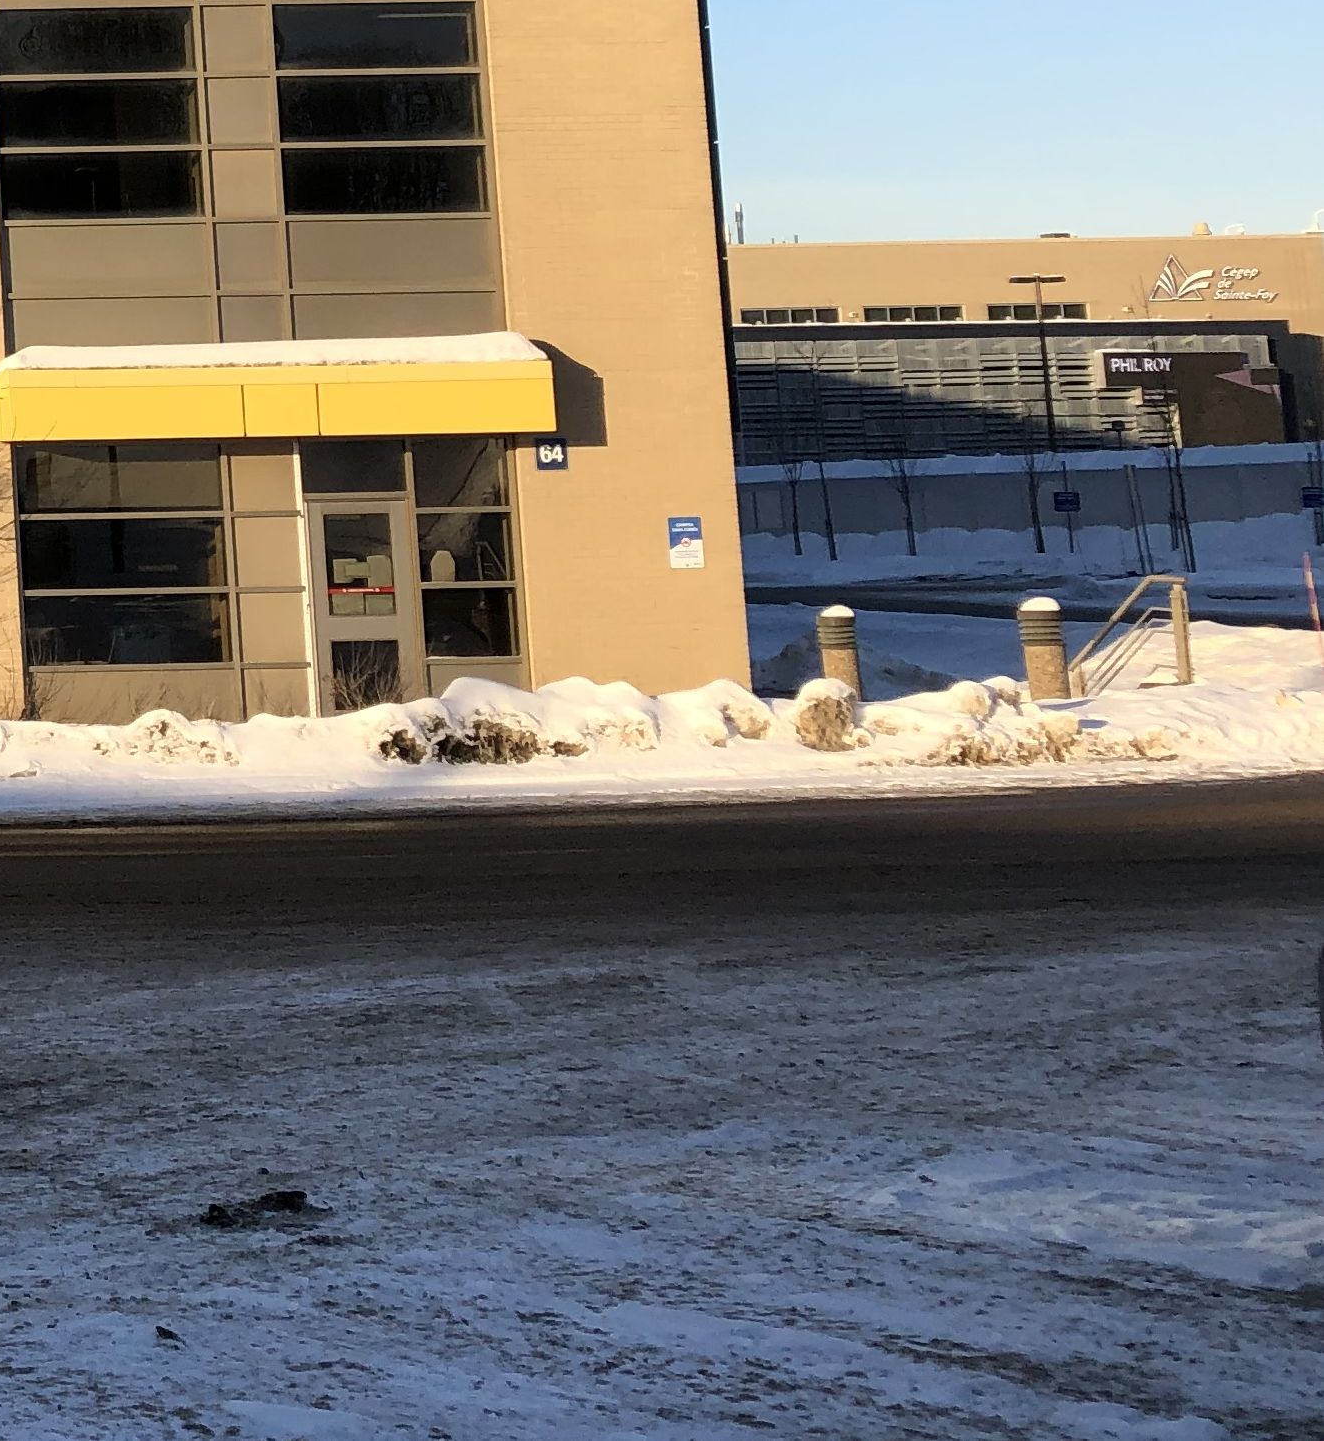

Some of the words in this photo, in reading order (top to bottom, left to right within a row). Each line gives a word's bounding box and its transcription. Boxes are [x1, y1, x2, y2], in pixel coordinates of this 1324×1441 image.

[1217, 278, 1233, 288] de
[1110, 357, 1142, 373] PHIL
[1143, 357, 1173, 372] ROY
[539, 444, 564, 463] 64
